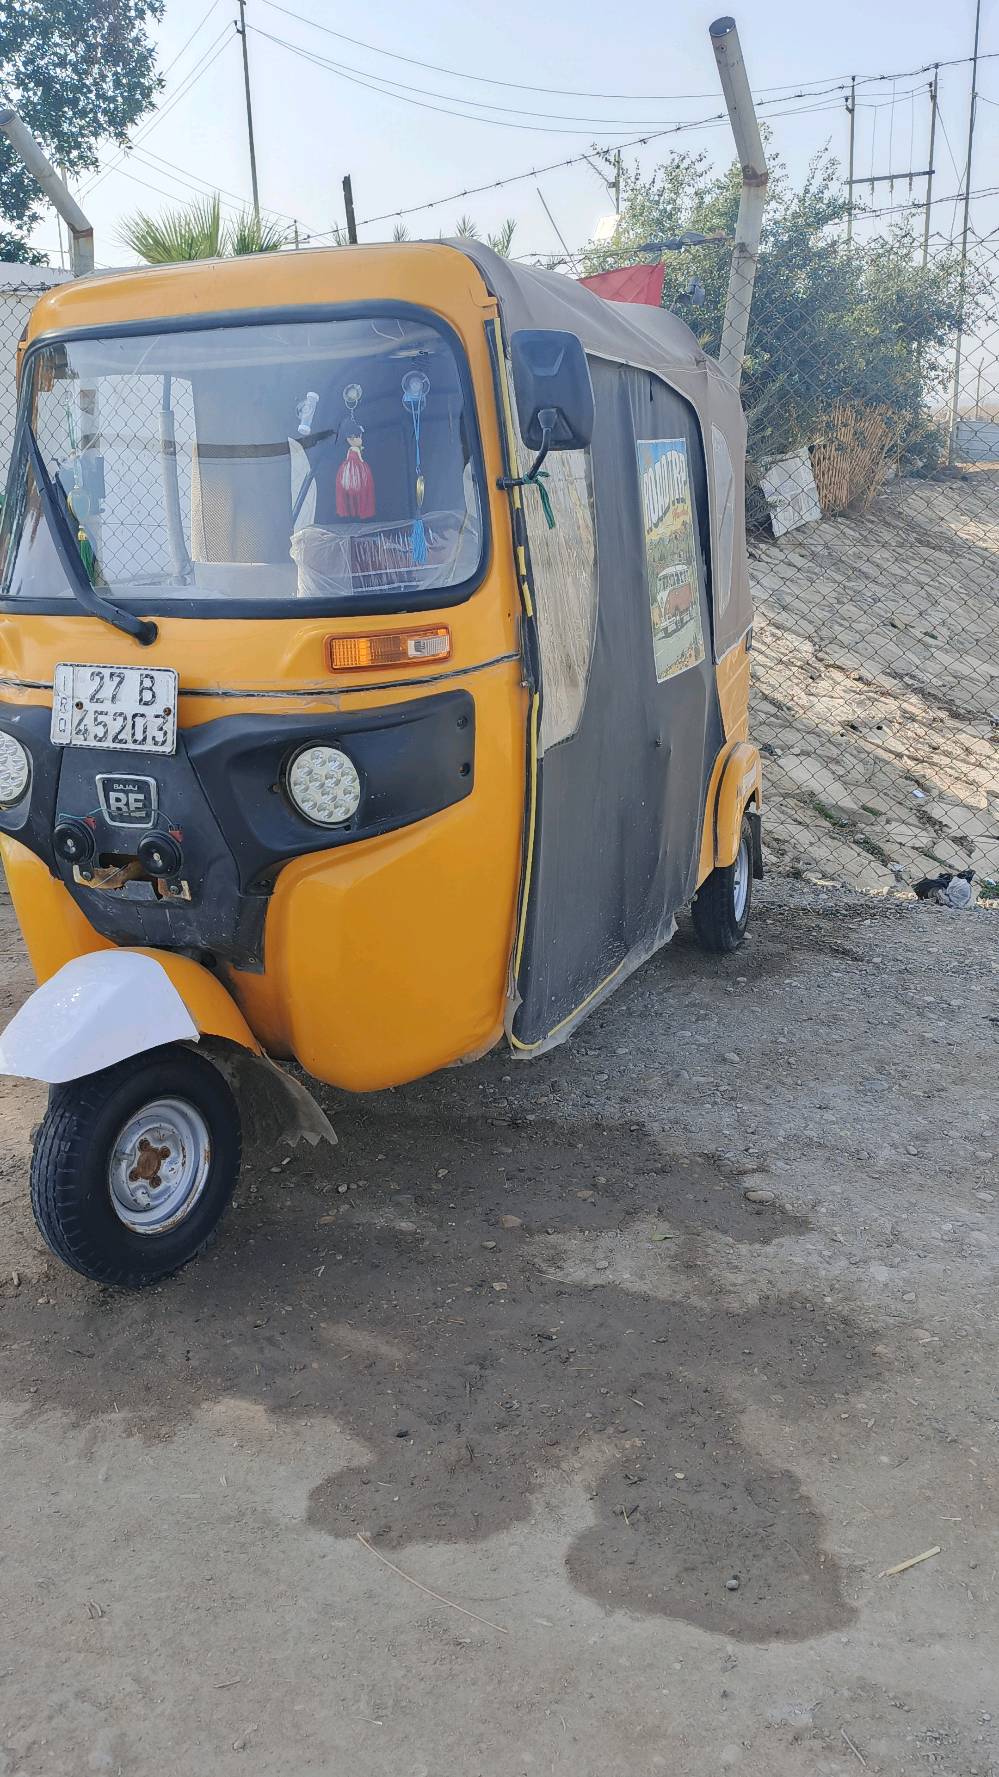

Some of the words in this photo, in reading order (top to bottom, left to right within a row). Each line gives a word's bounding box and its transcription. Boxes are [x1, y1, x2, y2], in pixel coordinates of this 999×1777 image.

[89, 671, 125, 704] 27
[139, 673, 156, 706] B
[75, 709, 168, 746] 45203
[109, 791, 146, 817] RE
